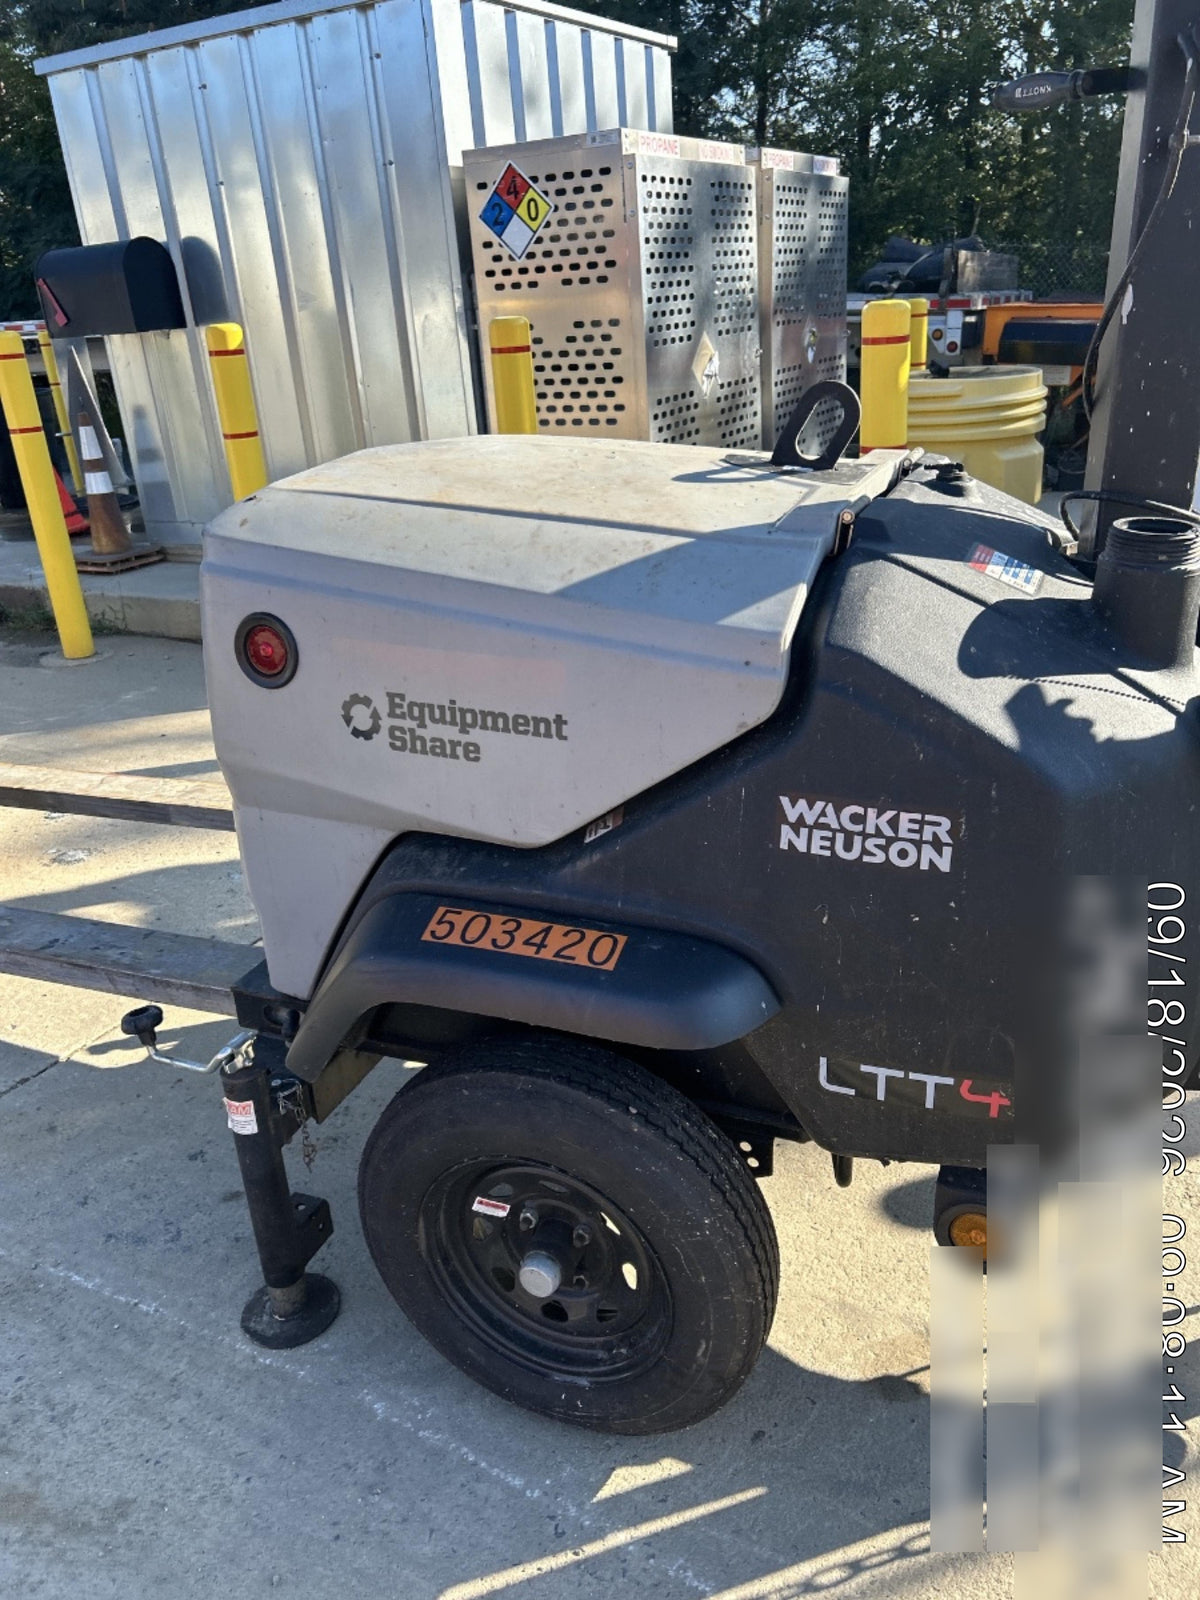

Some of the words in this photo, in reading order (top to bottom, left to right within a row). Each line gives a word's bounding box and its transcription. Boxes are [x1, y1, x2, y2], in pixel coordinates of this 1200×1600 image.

[640, 135, 679, 156] PROPANE
[491, 202, 505, 227] 2
[527, 197, 539, 222] 0
[506, 175, 520, 200] 4
[386, 691, 568, 741] Equipment
[388, 725, 481, 763] Share
[779, 795, 954, 844] WACKER
[779, 824, 953, 873] NEUSON
[430, 909, 619, 966] 503420
[818, 1056, 1011, 1118] LTT4
